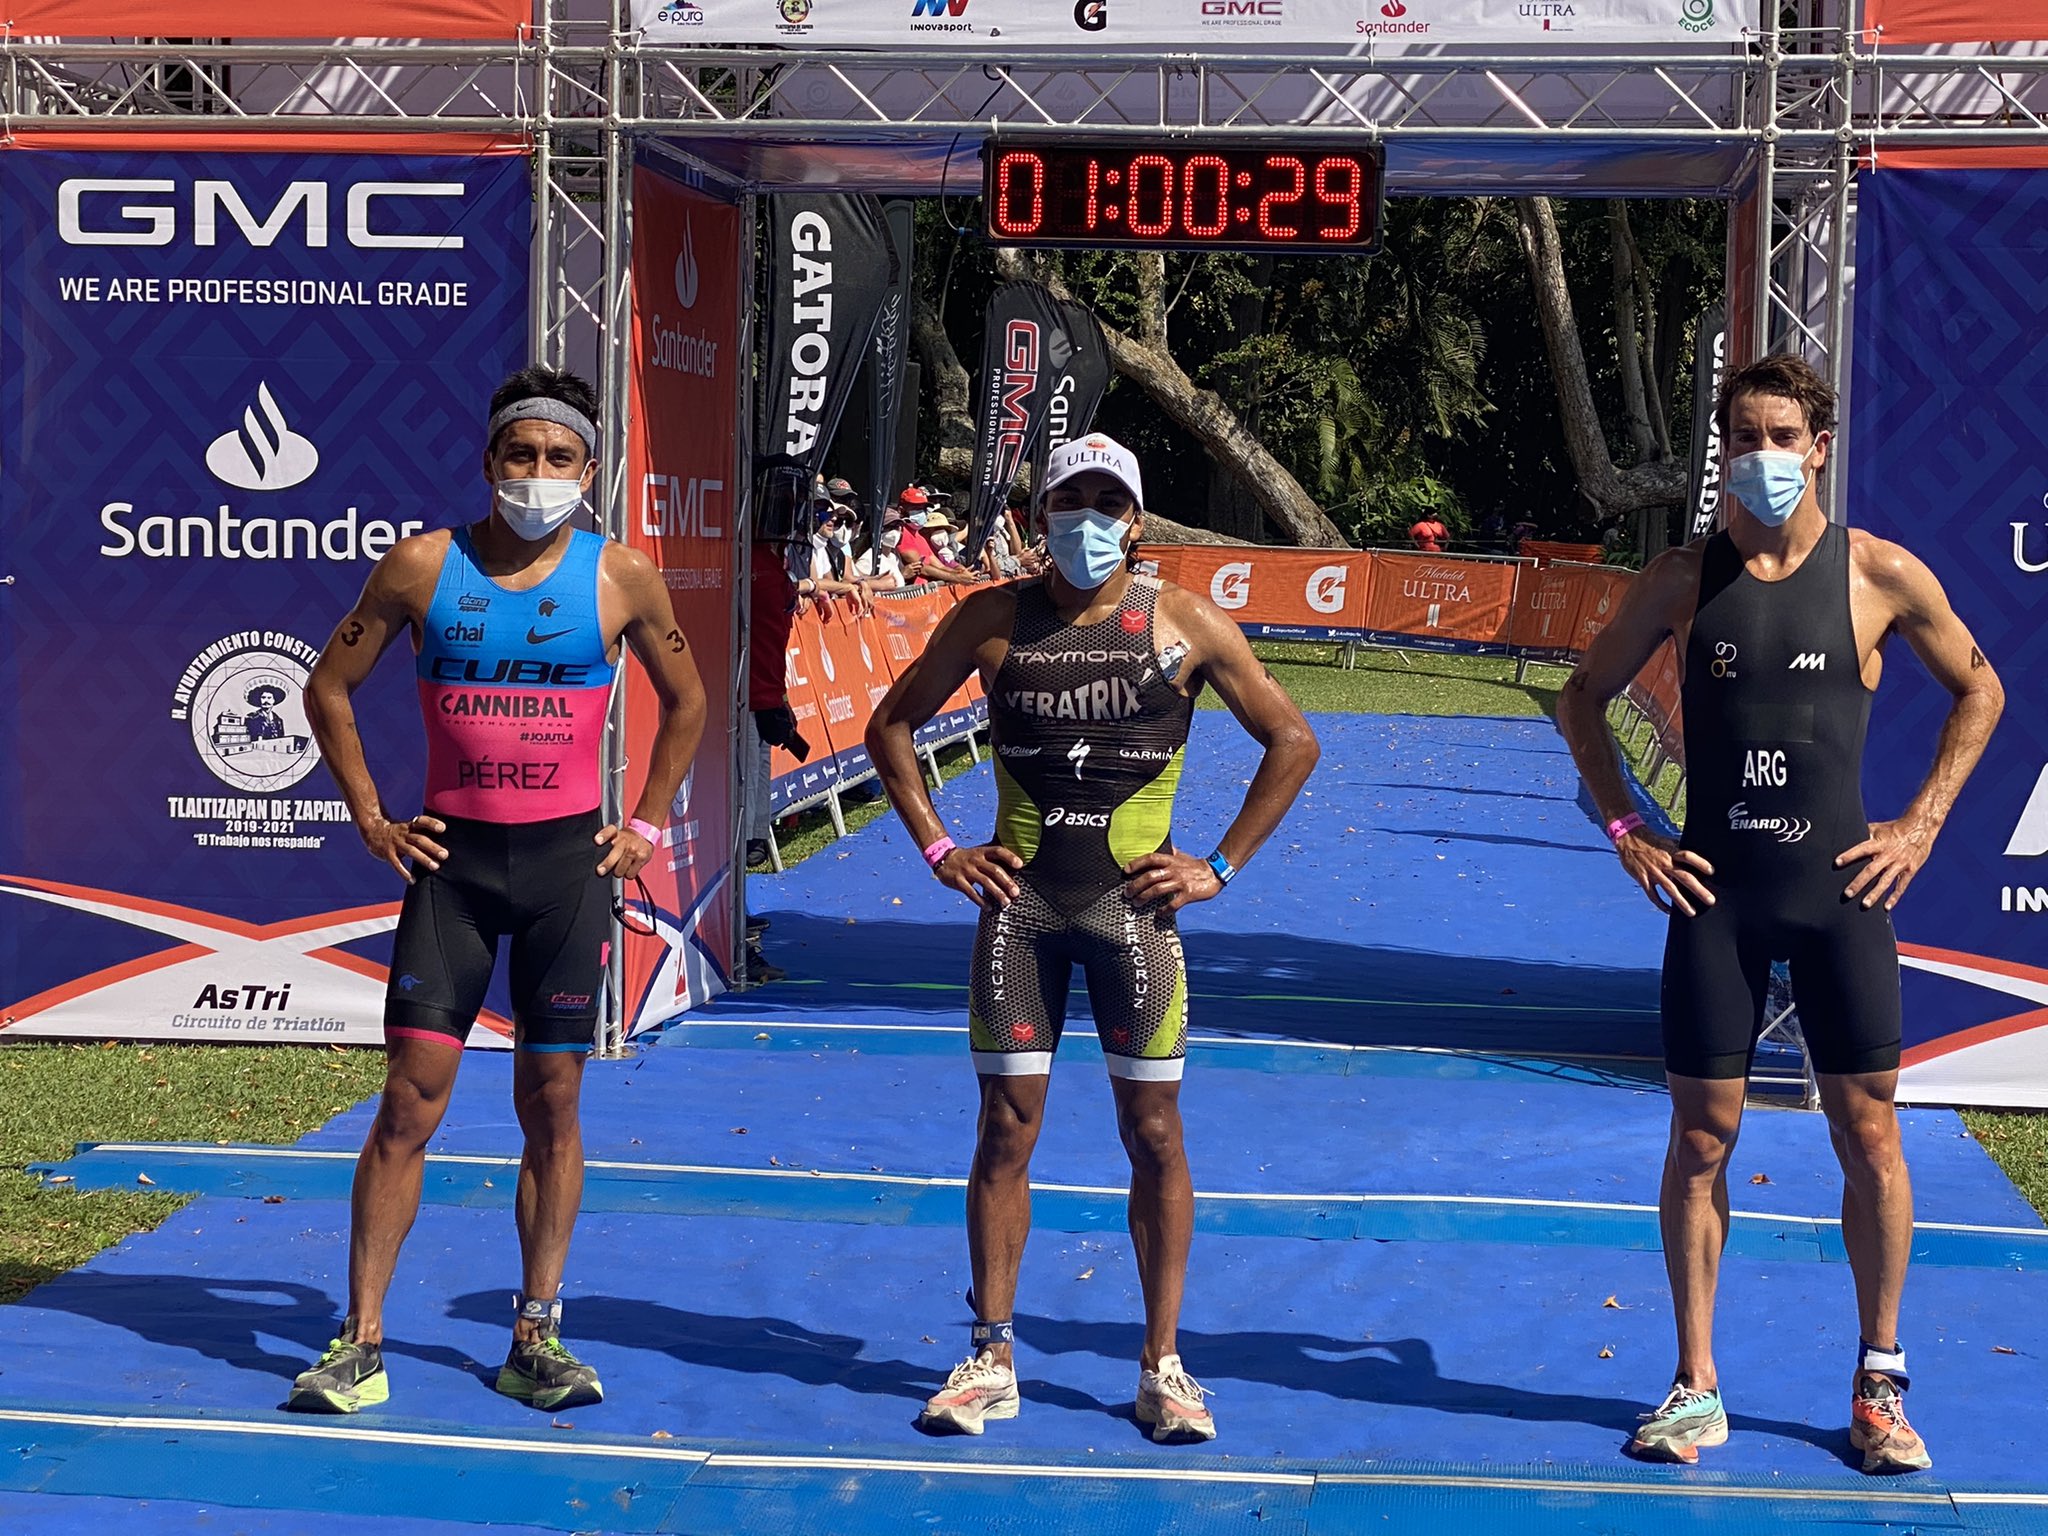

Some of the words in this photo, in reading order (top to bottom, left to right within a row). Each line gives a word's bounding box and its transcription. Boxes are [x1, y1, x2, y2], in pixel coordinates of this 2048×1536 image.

[1201, 1, 1283, 15] GMC
[1519, 4, 1576, 17] ULTRA
[1356, 21, 1430, 34] Santander
[1678, 17, 1717, 33] ECOCE
[58, 179, 465, 248] GMC
[60, 277, 100, 302] WE
[106, 279, 160, 303] ARE
[168, 280, 371, 306] PROFESSIONAL
[378, 282, 467, 307] GRADE
[651, 313, 717, 378] Santander
[786, 211, 832, 457] GATORA
[986, 368, 1001, 448] PROFESSIONAL
[994, 319, 1040, 484] GMC
[982, 453, 994, 486] GRADE
[1067, 451, 1122, 473] ULTRA
[641, 473, 723, 537] GMC
[1403, 580, 1472, 603] ULTRA
[1530, 592, 1567, 610] ULTRA
[341, 621, 365, 647] 3
[444, 621, 485, 642] chai
[666, 629, 686, 654] 3
[174, 630, 260, 706] AYUNTAMIENTO
[1013, 650, 1149, 664] TAYMORY
[431, 656, 592, 685] CUBE
[440, 693, 574, 719] CANNIBAL
[1004, 676, 1143, 720] VERATRIX
[520, 732, 574, 743] #JOJUTLA
[1119, 750, 1173, 761] GARMIN
[457, 755, 560, 790] PÉREZ
[1742, 750, 1787, 788] ARG
[168, 797, 267, 819] TLALTIZAPAN
[270, 799, 291, 820] DE
[293, 801, 352, 822] ZAPATA
[1065, 811, 1110, 827] asics
[225, 820, 295, 834] 2019-2021
[1730, 817, 1781, 830] ENARD
[209, 834, 250, 848] Trabajo
[251, 836, 271, 848] nos
[1124, 912, 1149, 1009] VERACRUZ
[193, 984, 291, 1011] AsTri
[171, 1014, 241, 1030] Circuito
[246, 1016, 267, 1031] de
[272, 1017, 345, 1032] Triatlón
